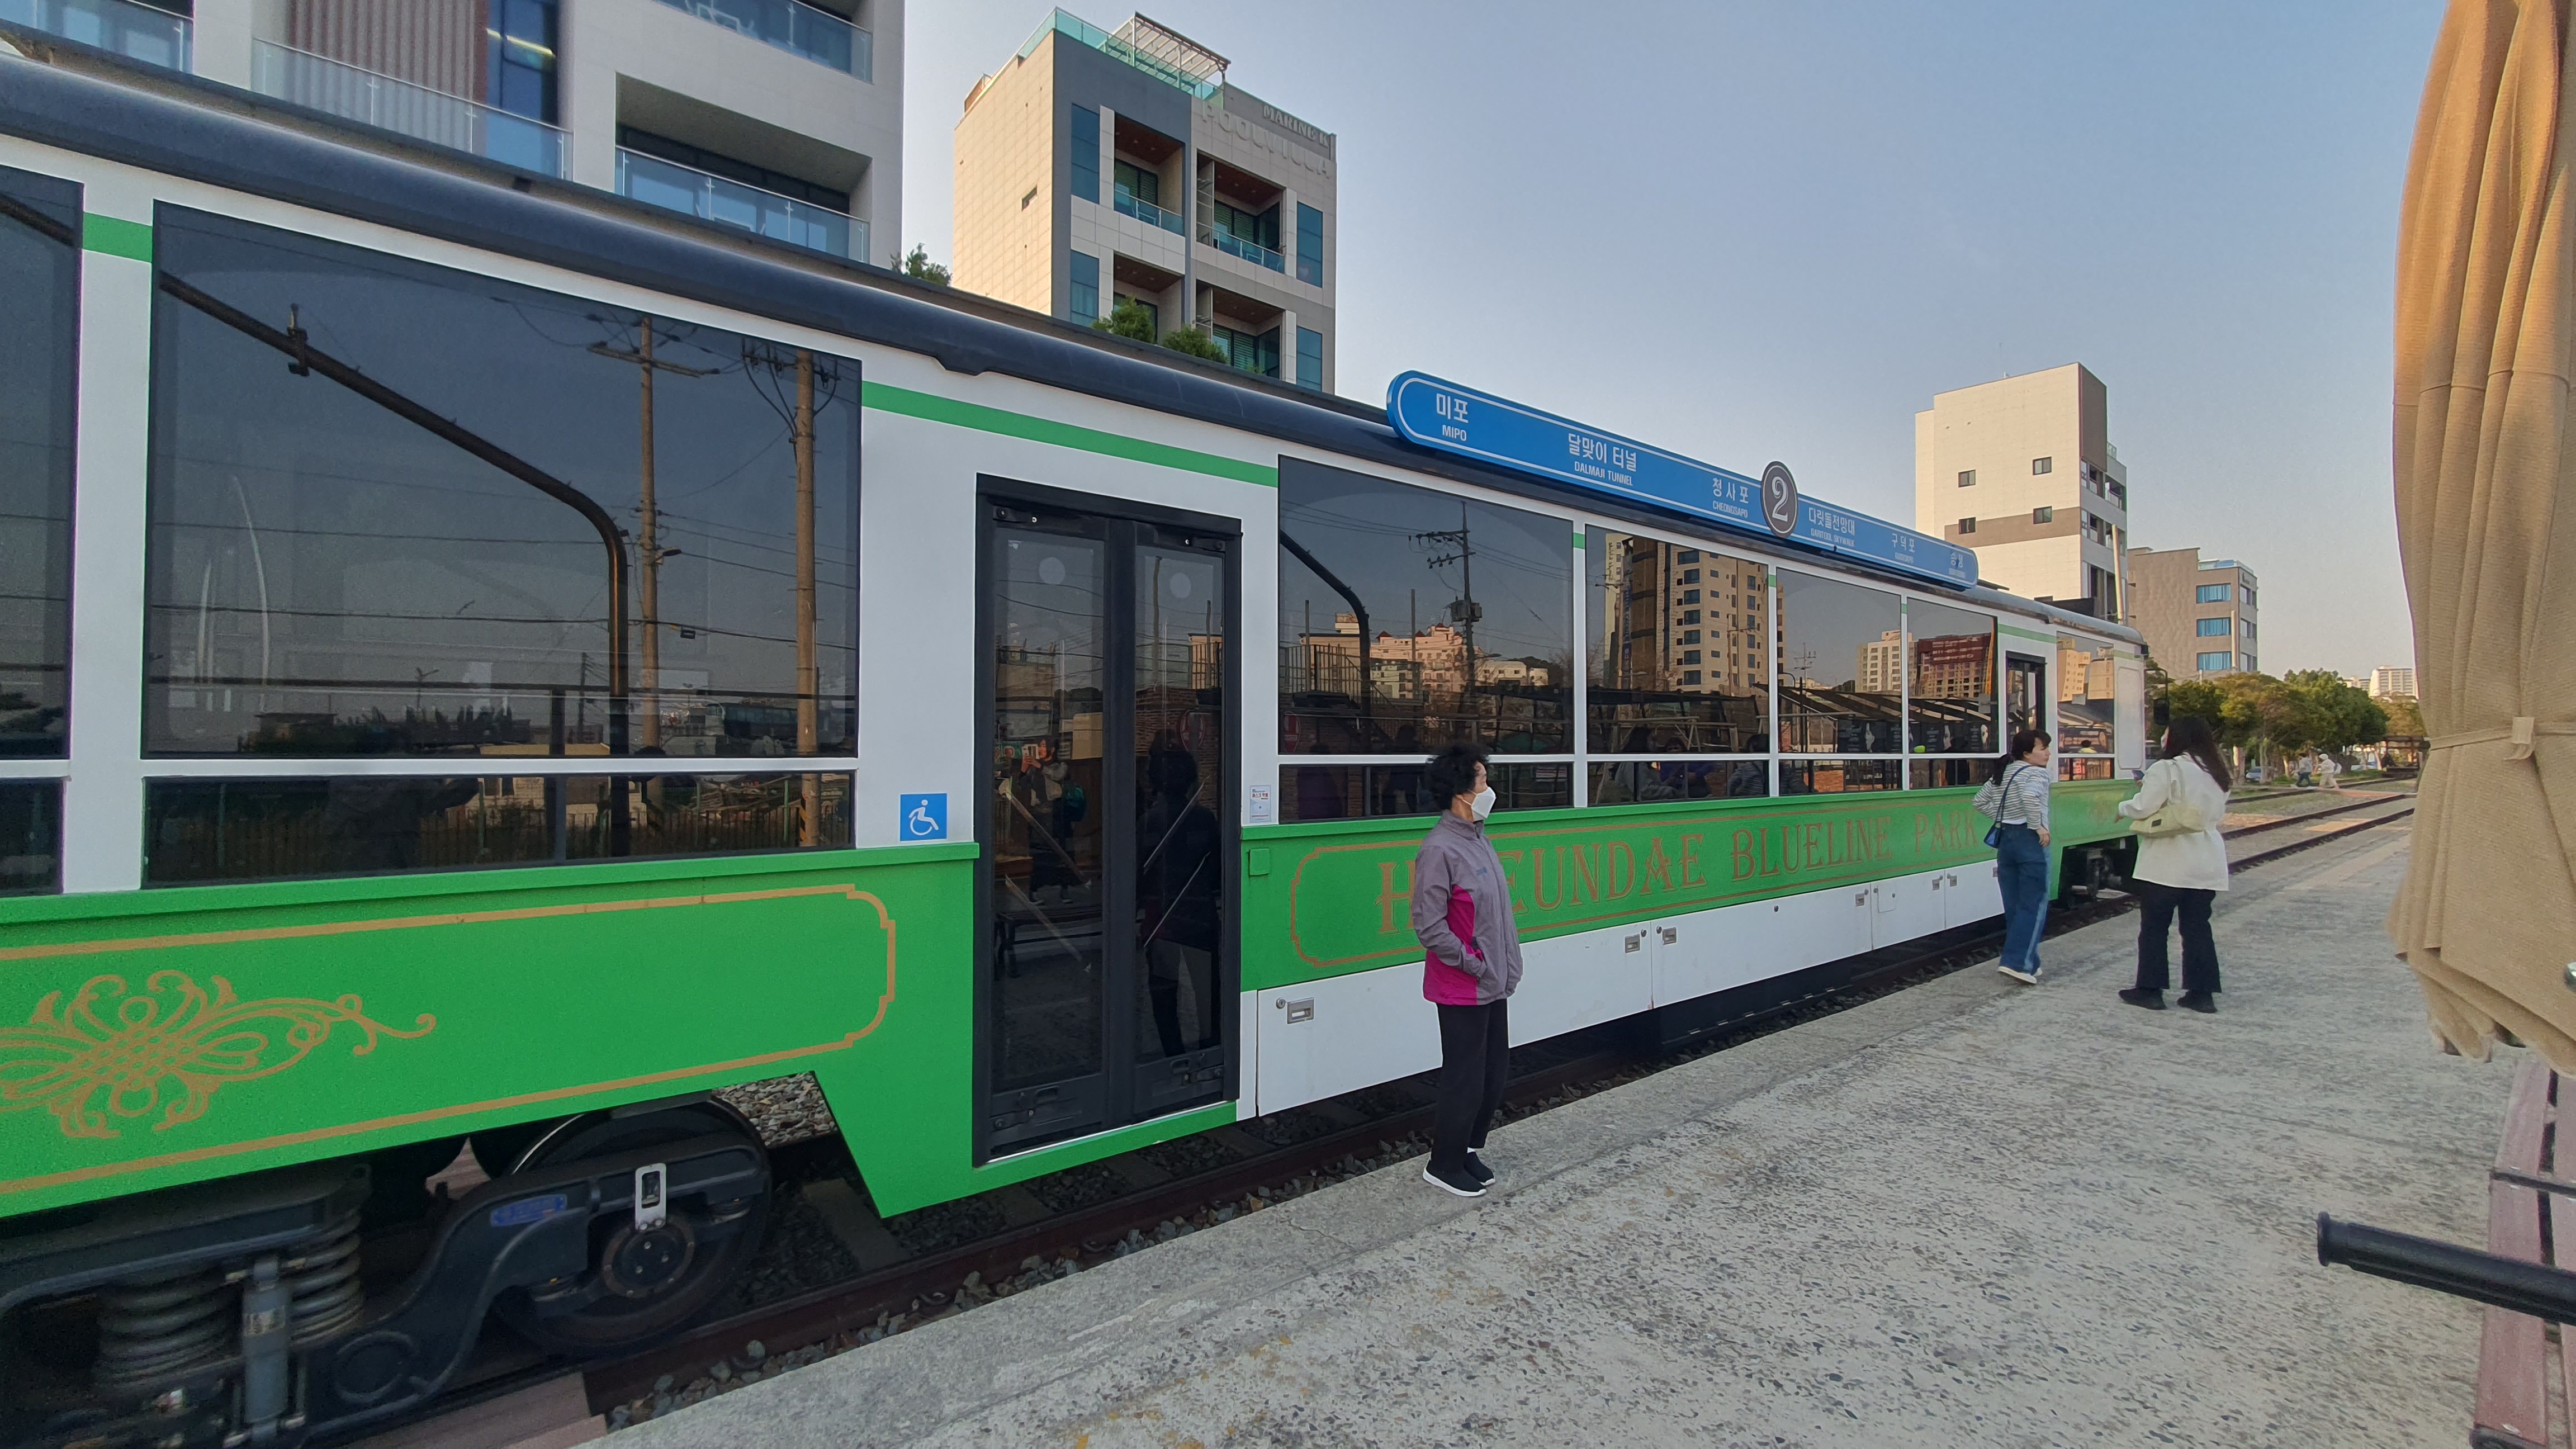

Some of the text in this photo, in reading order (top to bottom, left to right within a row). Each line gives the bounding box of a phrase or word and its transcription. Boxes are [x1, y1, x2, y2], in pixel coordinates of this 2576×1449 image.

[1263, 105, 1329, 148] MARINE K
[1436, 393, 1469, 423] 미포
[1442, 424, 1467, 442] MIPO
[1568, 433, 1637, 472] 달맞이 터널
[1574, 461, 1633, 486] DALMAJI TUNNEL
[1712, 477, 1749, 504] 청사포
[1772, 476, 1789, 522] 2
[1712, 500, 1748, 518] CHEONGSAPO
[1808, 507, 1855, 536] 다릿돌전망대
[1891, 533, 1915, 553] 구덕포
[1375, 808, 1978, 936] HEUNDAE BLUELINE PARK
